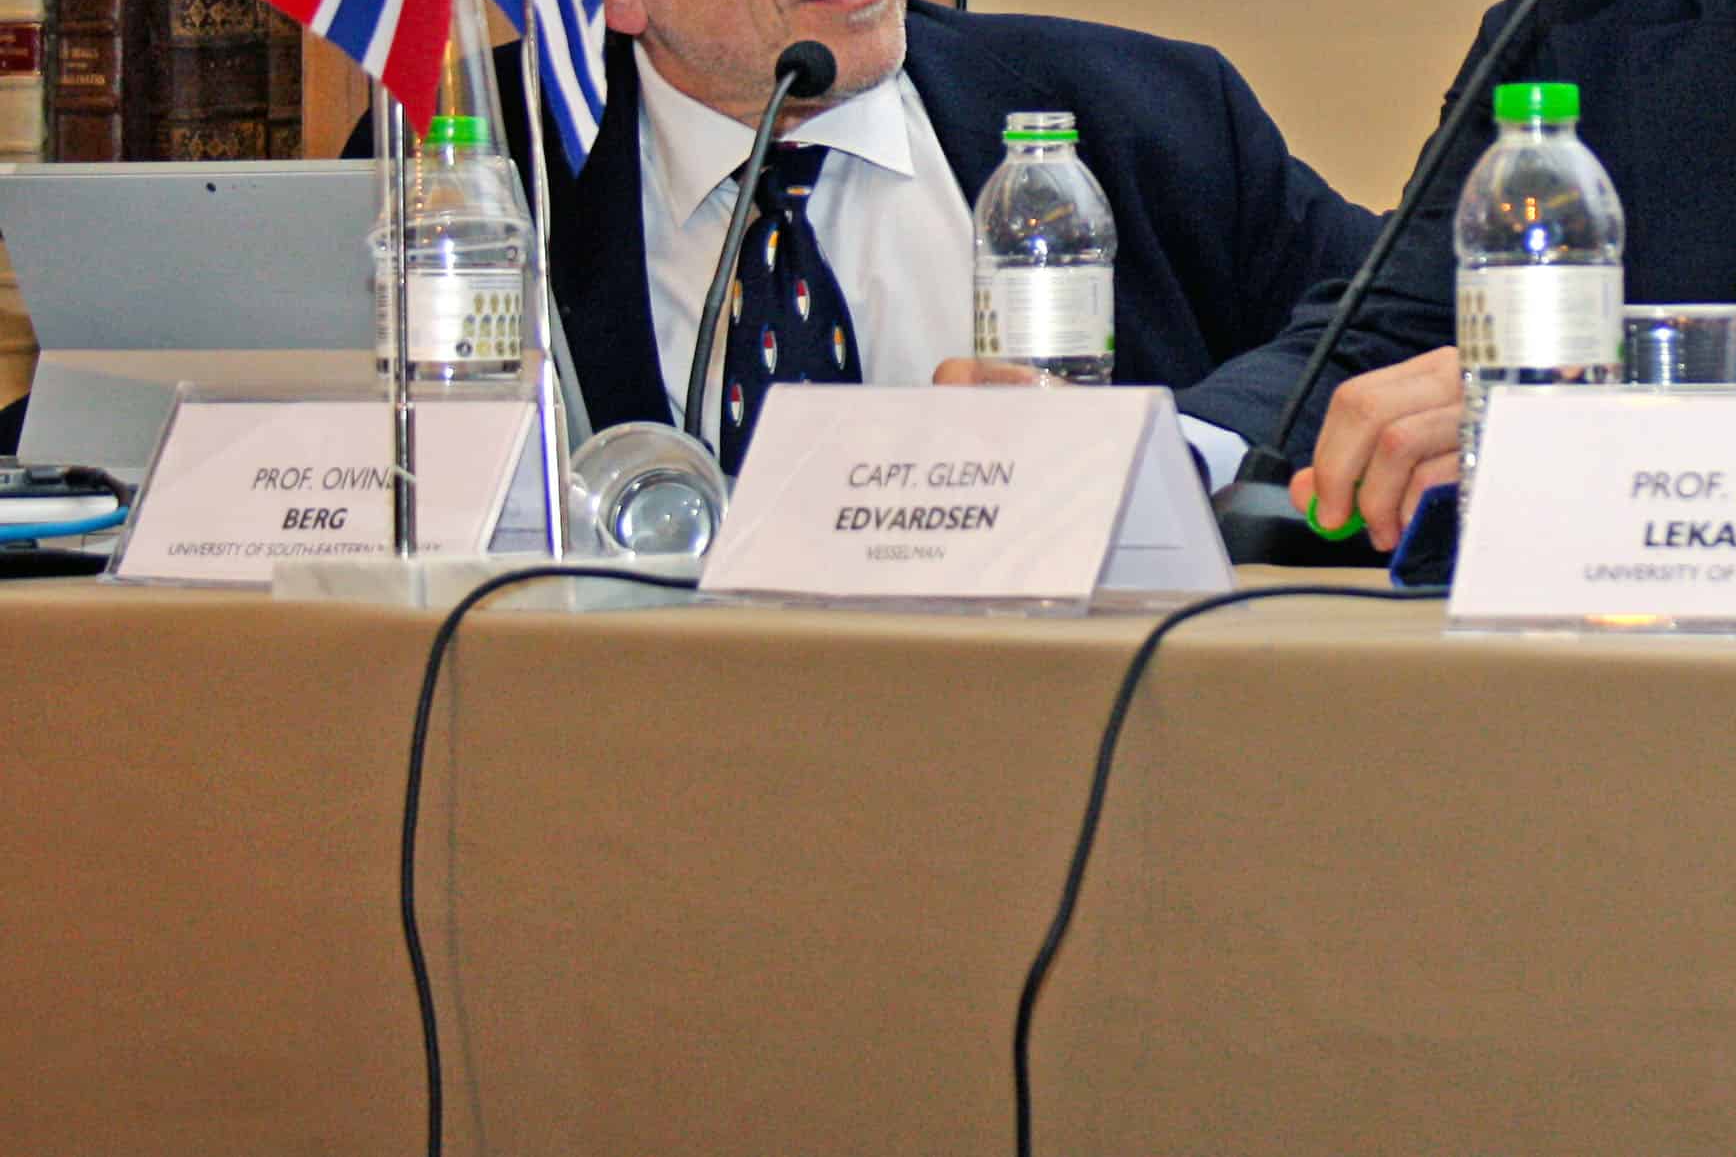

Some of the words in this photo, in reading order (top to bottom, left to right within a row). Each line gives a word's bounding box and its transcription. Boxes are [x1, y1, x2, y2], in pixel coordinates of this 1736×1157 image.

[251, 467, 312, 490] PROF.
[323, 467, 396, 490] OIVIN
[848, 463, 917, 489] CAPT.
[927, 461, 1015, 487] GLENN
[1631, 471, 1726, 500] PROF.
[282, 508, 348, 530] BERG
[835, 505, 1000, 530] EDVARDSEN
[168, 543, 243, 556] UNIVERSITY
[245, 543, 263, 556] OF
[866, 545, 945, 560] VESSELMAN
[1584, 563, 1699, 583] UNIVERSITY
[1708, 563, 1736, 582] OF
